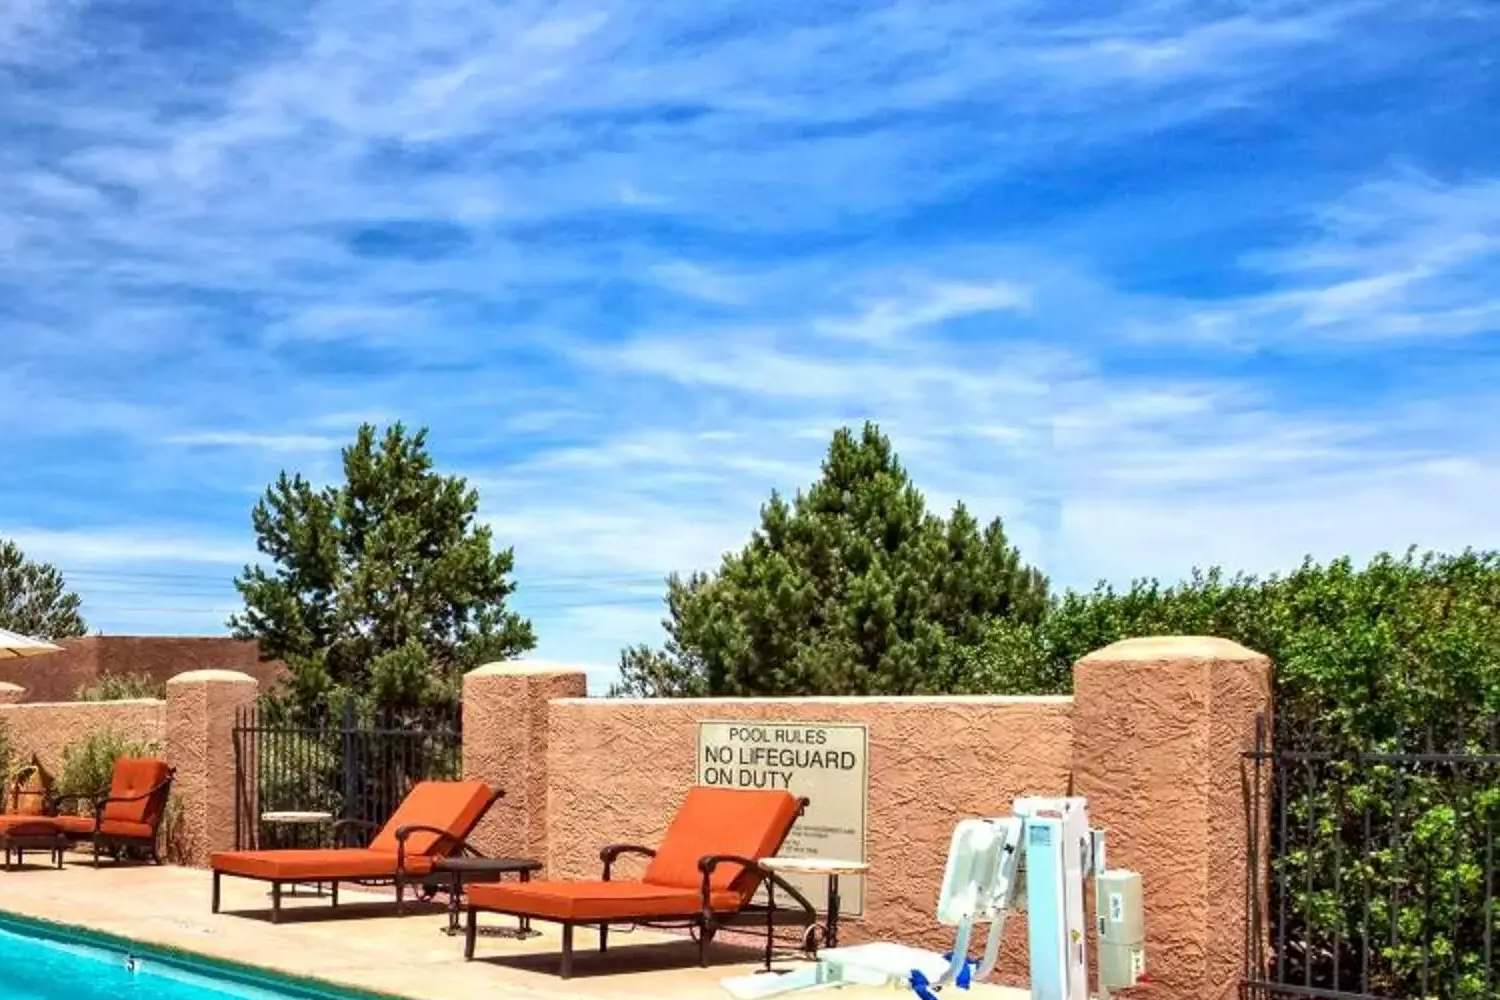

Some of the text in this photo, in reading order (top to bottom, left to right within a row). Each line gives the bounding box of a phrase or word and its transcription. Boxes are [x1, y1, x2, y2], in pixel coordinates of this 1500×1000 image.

[729, 727, 827, 745] POOL RULES
[705, 745, 855, 770] NO LIFEGUARD
[704, 767, 793, 788] ON DUTY
